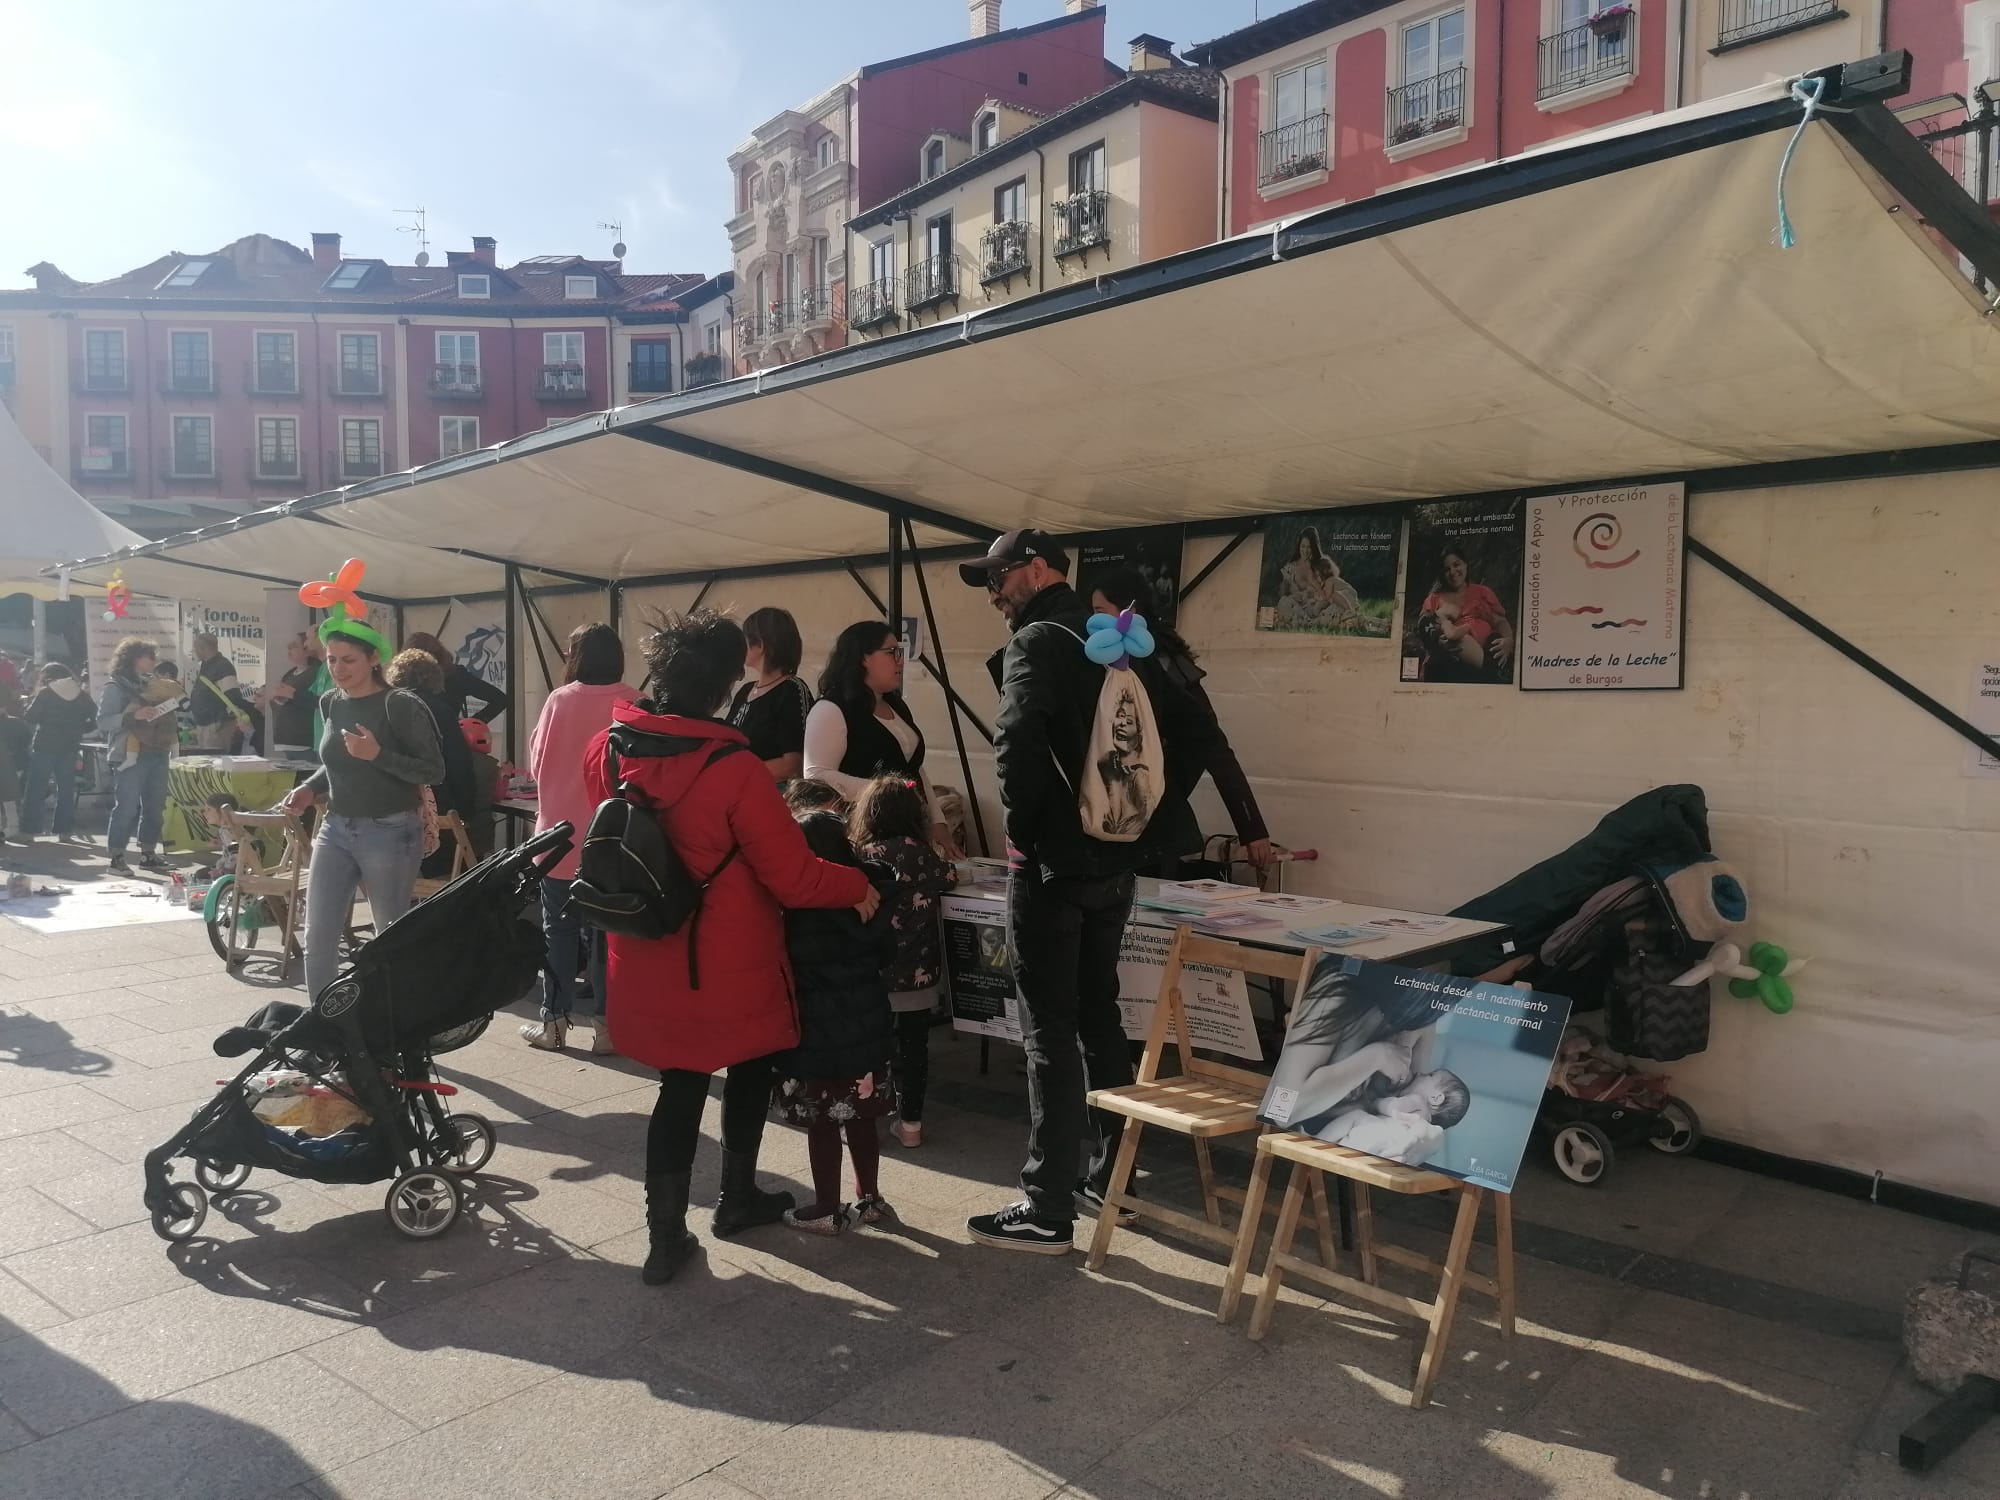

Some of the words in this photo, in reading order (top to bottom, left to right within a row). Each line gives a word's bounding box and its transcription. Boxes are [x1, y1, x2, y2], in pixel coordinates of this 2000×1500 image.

[1558, 497, 1567, 508] Y
[1572, 488, 1648, 508] Protección
[1432, 516, 1462, 526] Lactancia
[1463, 516, 1472, 524] en
[1474, 514, 1481, 522] el
[1482, 512, 1516, 522] embarazo
[1332, 532, 1359, 540] Lactancia
[1370, 531, 1392, 540] tándem
[1459, 527, 1489, 536] lactancia
[1490, 524, 1514, 533] normal
[1530, 508, 1545, 548] Apoyo
[1343, 543, 1369, 551] lactancia
[1370, 543, 1391, 551] normal
[1666, 525, 1680, 584] Lactancia
[1533, 552, 1541, 568] de
[204, 607, 239, 622] foro
[1528, 573, 1540, 642] Asociación
[204, 624, 263, 639] familia
[1585, 654, 1602, 667] de
[1607, 653, 1620, 666] la
[1569, 675, 1582, 684] de
[1586, 674, 1623, 686] Burgos
[1394, 975, 1439, 993] Lactancia
[1443, 985, 1472, 999] desde
[1476, 991, 1487, 1000] el
[1490, 994, 1549, 1013] nacimiento
[1430, 999, 1450, 1012] Una
[1453, 1003, 1500, 1022] lactancia
[1503, 1014, 1543, 1031] normal
